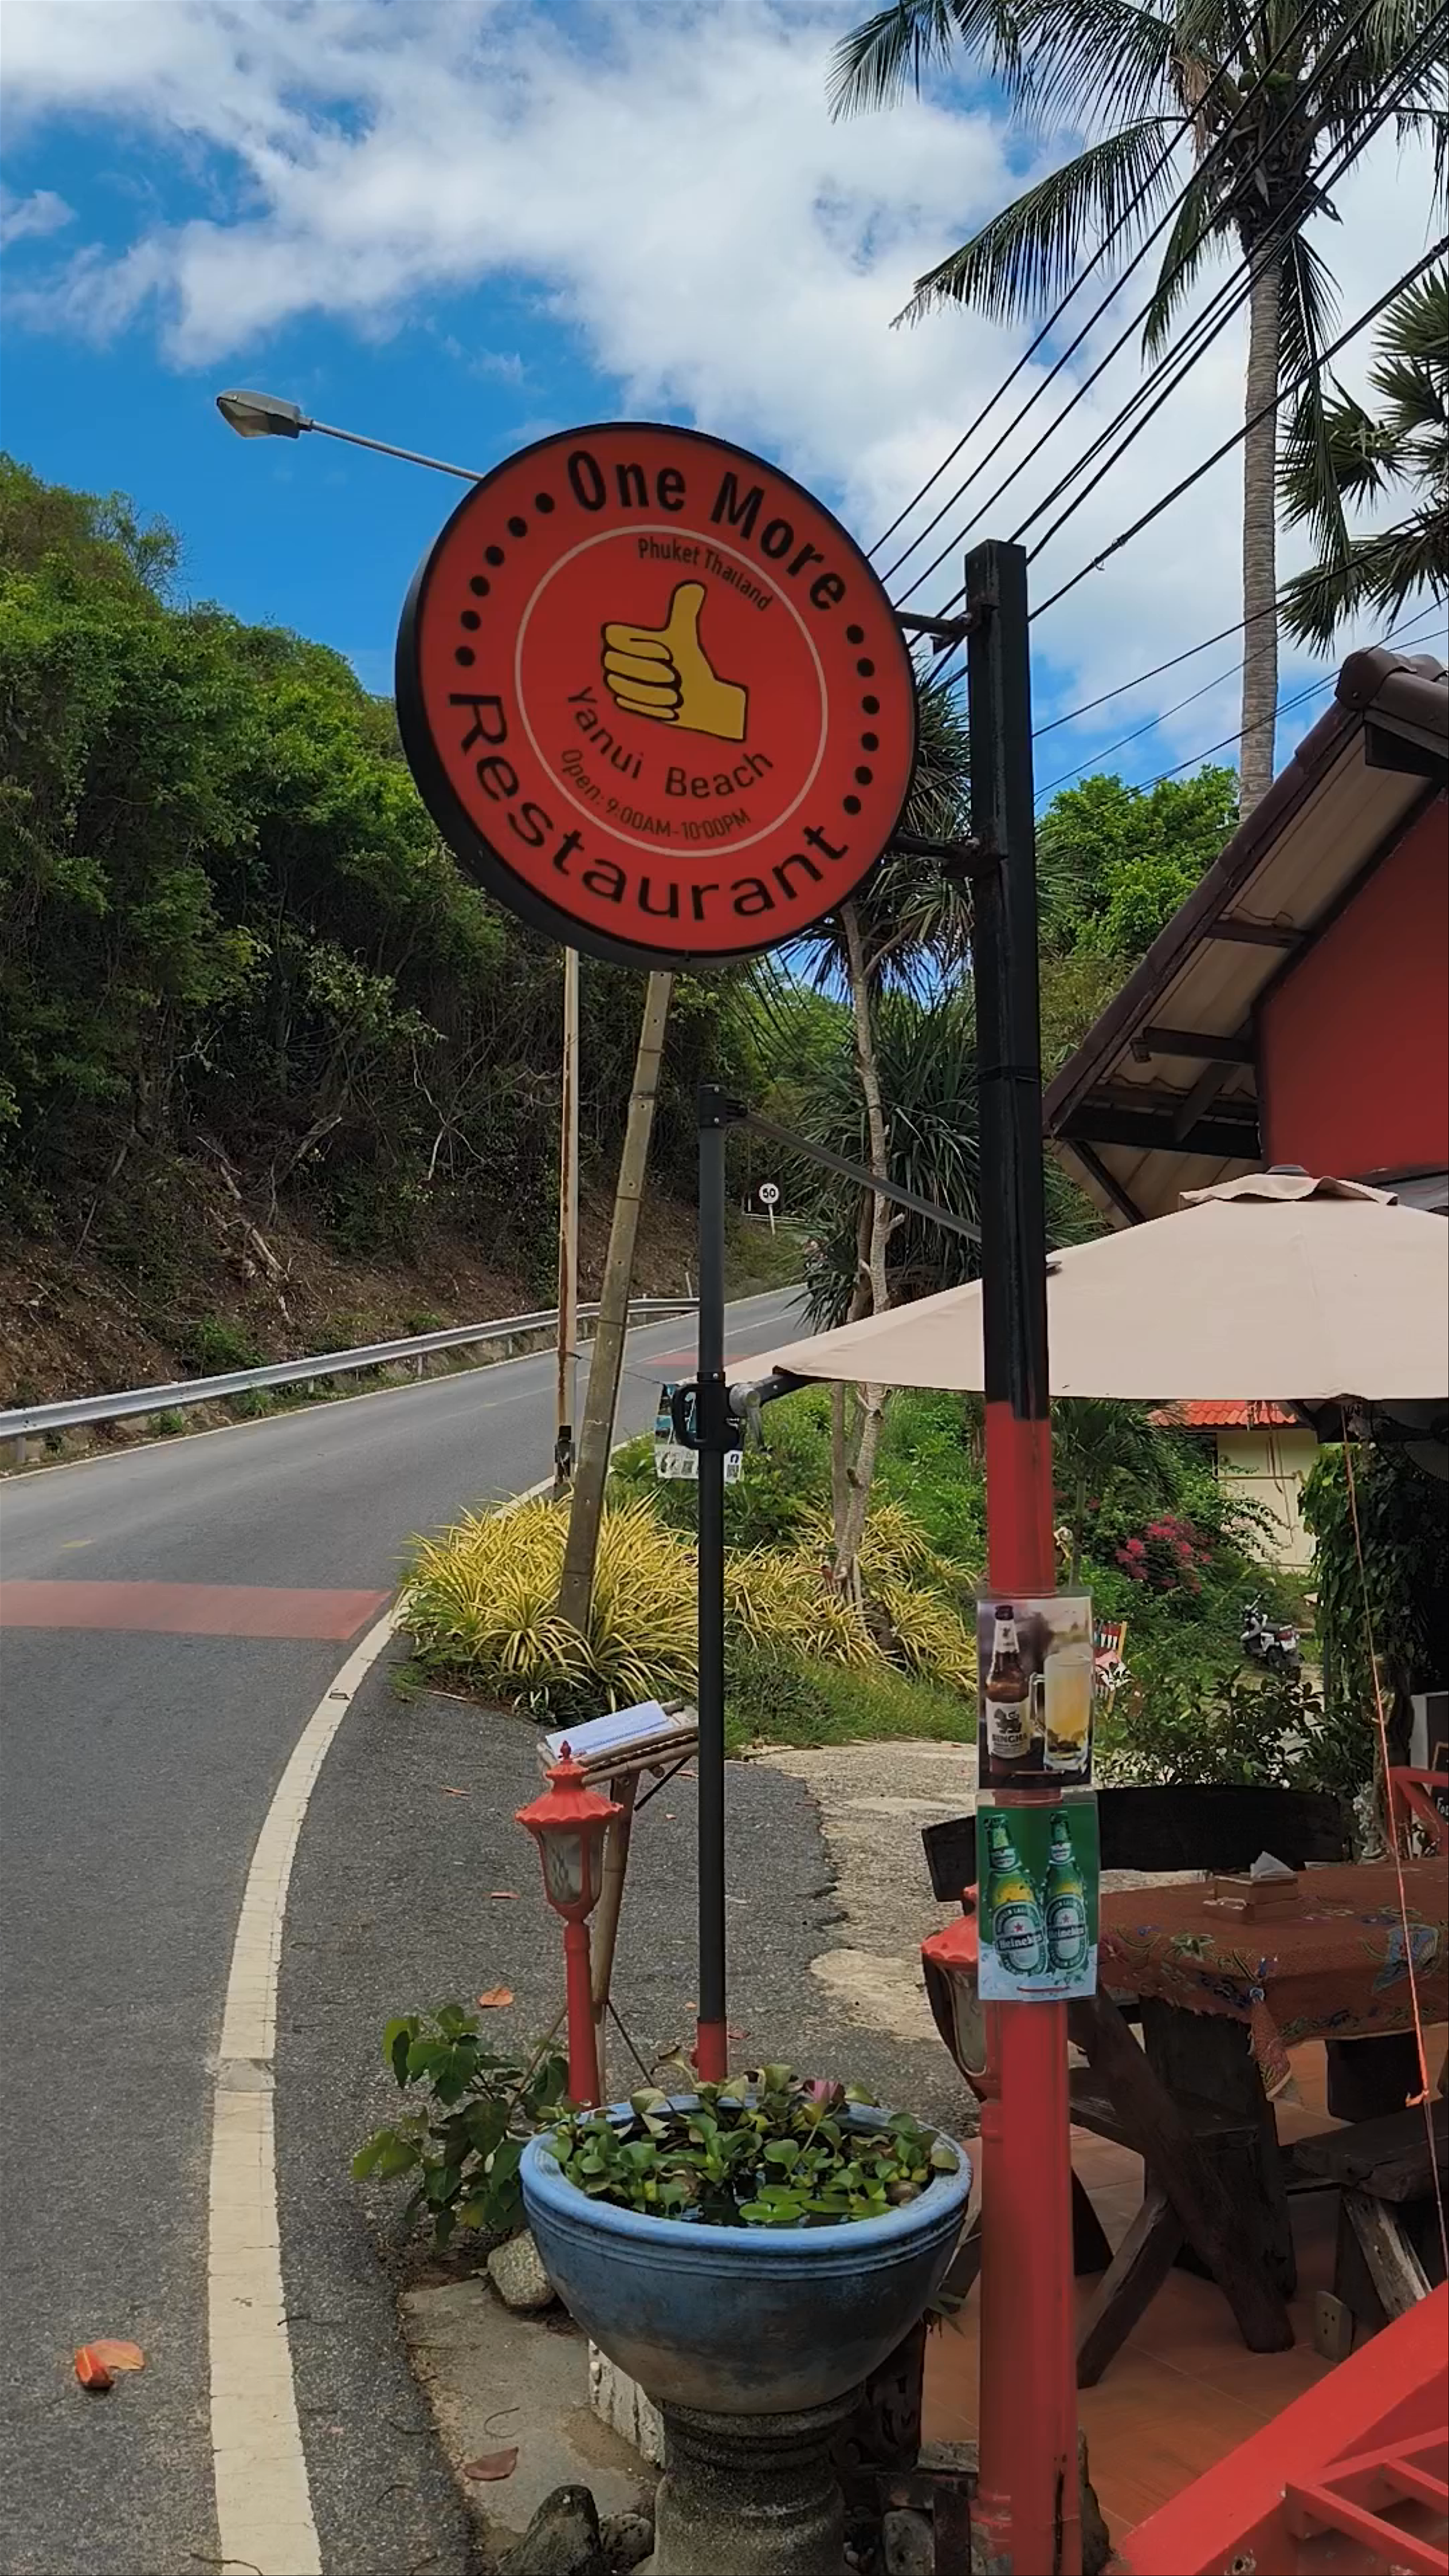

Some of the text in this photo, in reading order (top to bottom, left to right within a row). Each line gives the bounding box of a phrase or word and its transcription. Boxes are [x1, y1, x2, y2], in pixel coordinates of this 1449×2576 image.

[567, 450, 846, 611] One More
[638, 537, 774, 612] Phuket Thailand
[561, 749, 605, 805] Open:
[567, 686, 774, 800] Yanui Beach
[448, 693, 849, 921] Restaurant
[762, 1188, 776, 1198] 50
